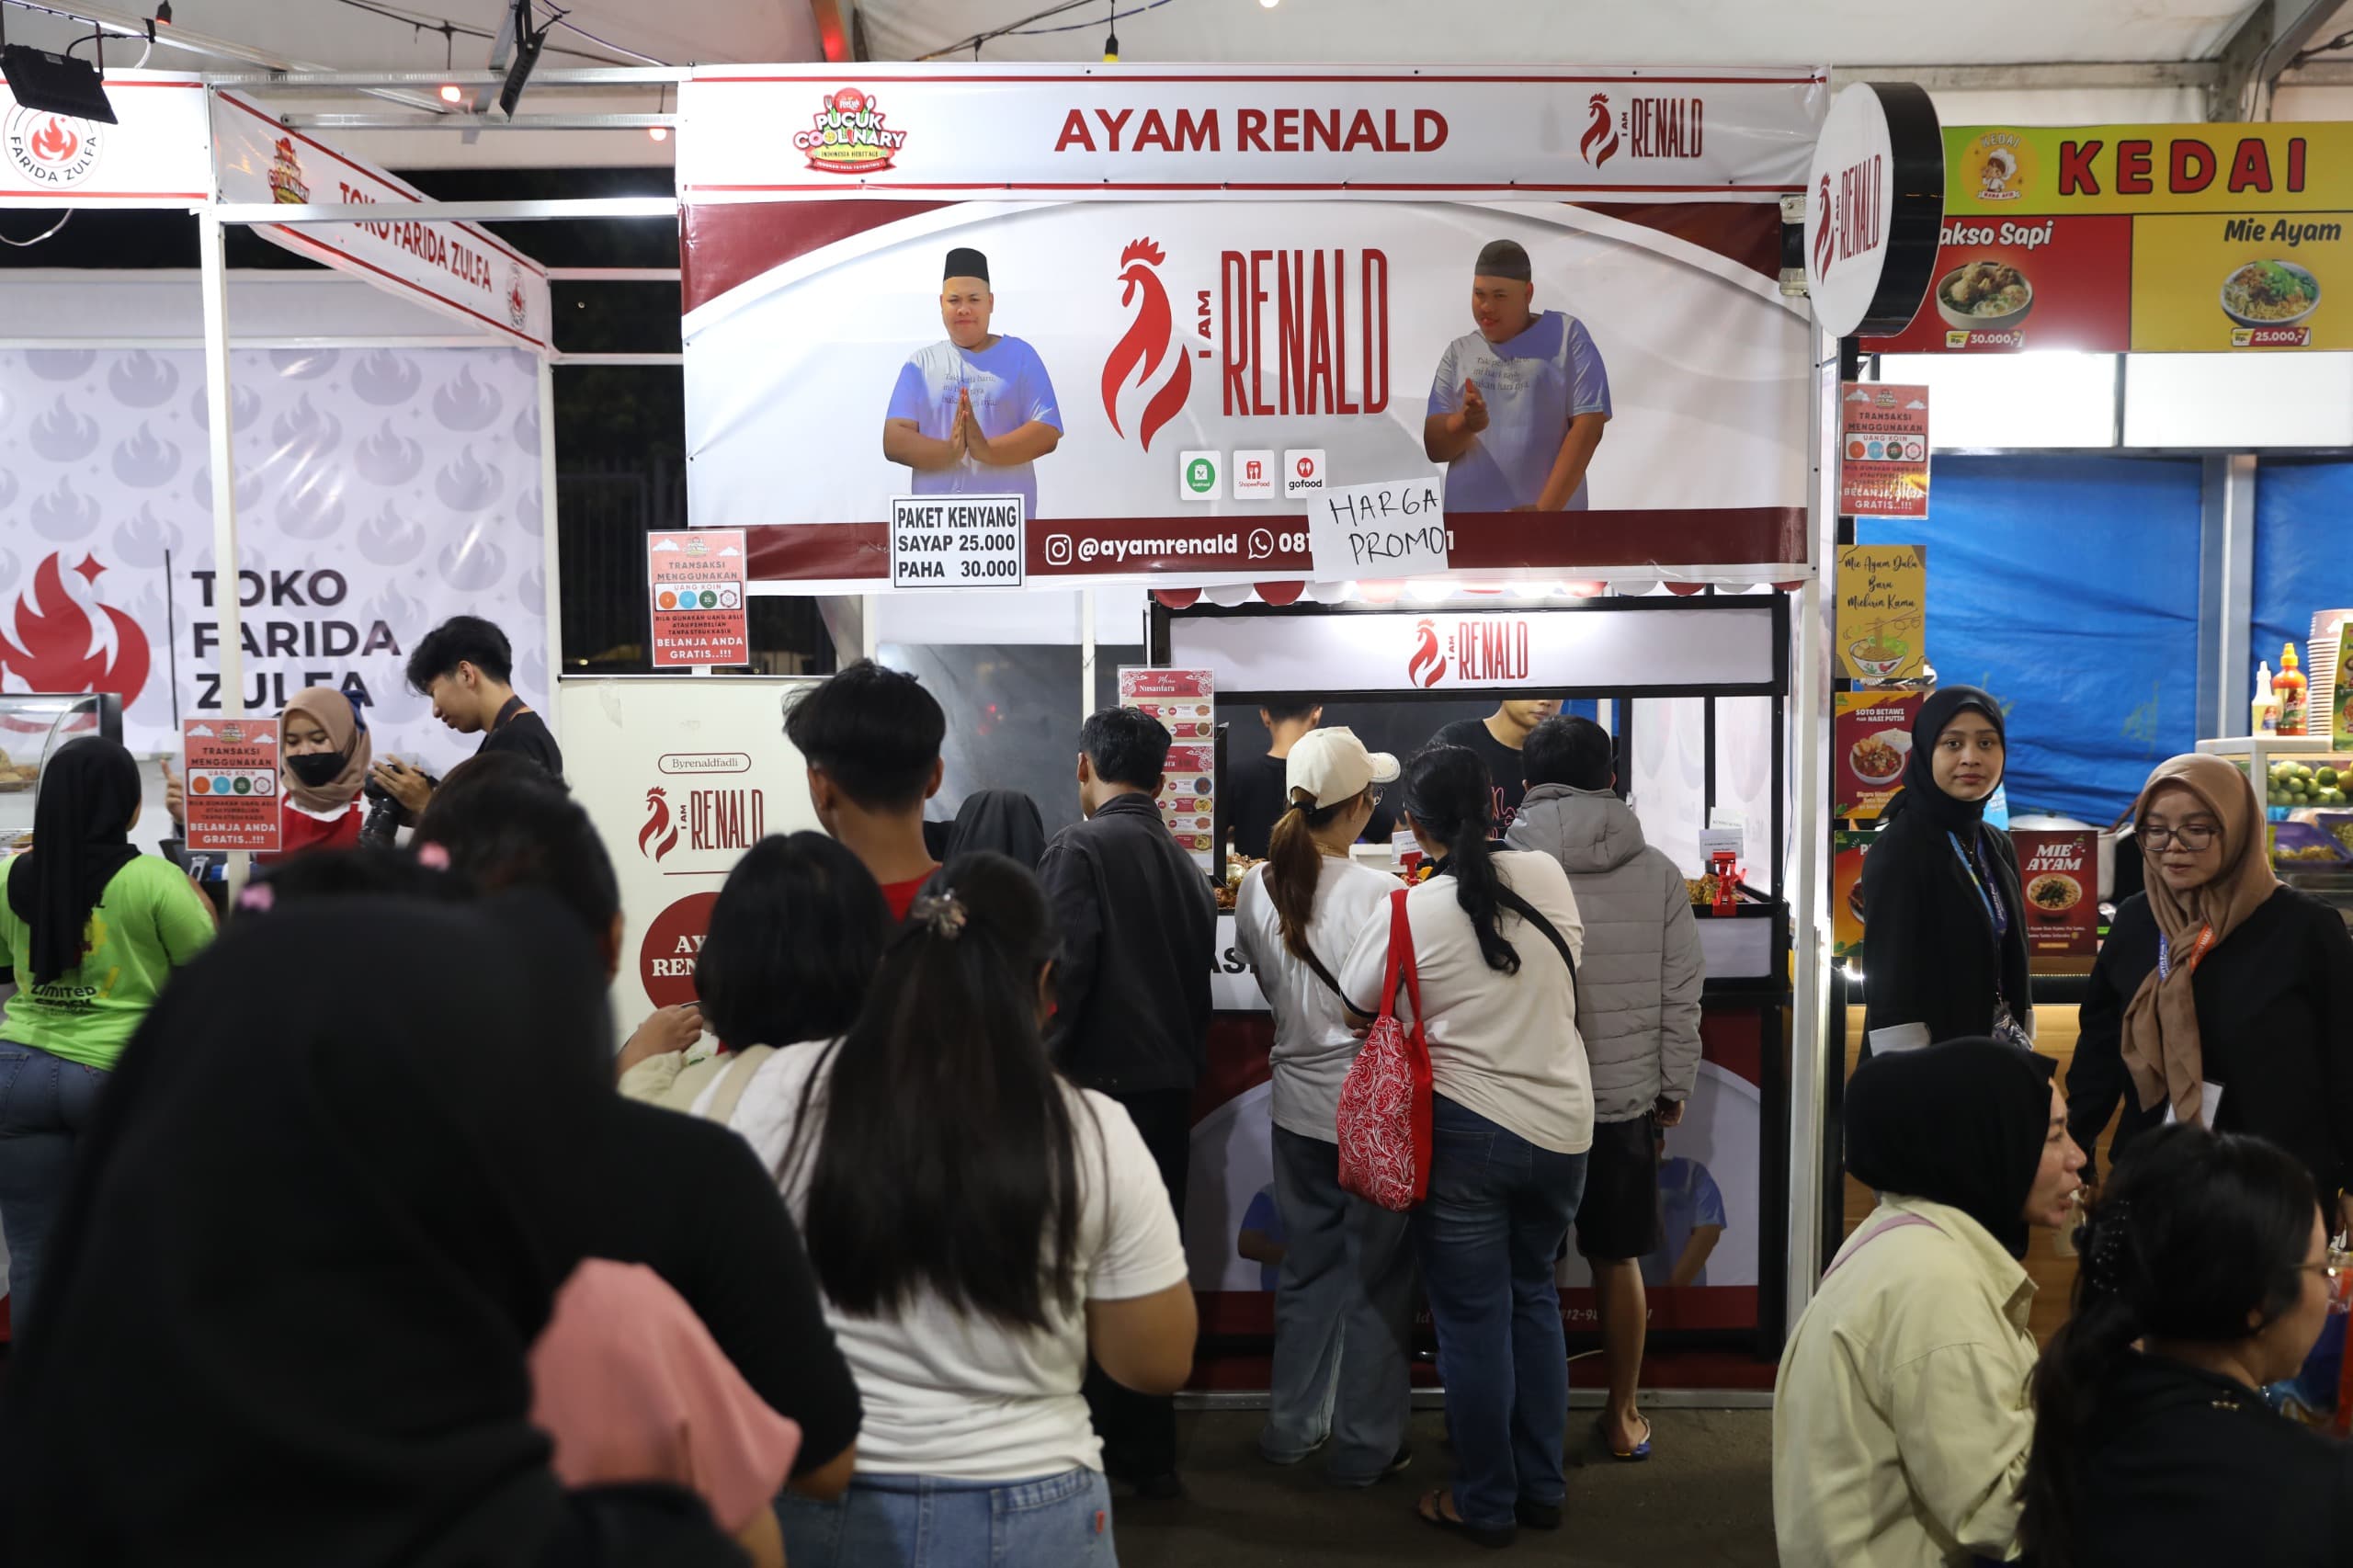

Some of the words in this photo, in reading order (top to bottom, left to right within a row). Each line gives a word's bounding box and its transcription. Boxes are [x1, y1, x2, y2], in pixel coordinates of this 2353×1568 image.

[814, 111, 884, 131] PUCUK
[1054, 108, 1221, 152] AYAM
[1237, 108, 1449, 152] RENALD
[1631, 97, 1703, 158] RENALD
[793, 129, 906, 149] COOLINARY
[1981, 133, 2021, 148] KEDAI
[11, 137, 58, 182] FARIDA
[64, 137, 96, 180] ZULFA
[2058, 138, 2307, 196] KEDAI
[1840, 154, 1881, 261] RENALD
[1940, 222, 1995, 245] akso
[1999, 220, 2053, 250] Sapi
[2224, 218, 2266, 243] Mie
[2270, 219, 2342, 247] Ayam
[393, 221, 449, 270] FARIDA
[450, 241, 492, 293] ZULFA
[1198, 290, 1211, 339] AM
[1222, 248, 1389, 416] RENALD
[1199, 350, 1211, 358] I
[1848, 424, 1923, 432] MENGGUNAKAN
[1289, 479, 1323, 490] gofood
[897, 507, 943, 528] PAKET
[948, 506, 1017, 528] KENYANG
[1329, 488, 1439, 527] HARGA
[898, 535, 953, 551] SAYAP
[959, 534, 1016, 551] 25.000
[1078, 533, 1238, 562] @ayamrenald
[1348, 526, 1445, 565] PROMO
[899, 561, 945, 578] PAHA
[961, 560, 1017, 577] 30.000
[1845, 557, 1860, 571] Mie
[1864, 556, 1890, 573] Ayam
[657, 573, 737, 581] MENGGUNAKAN
[1869, 574, 1893, 592] Baru
[191, 569, 347, 607] TOKO
[1888, 594, 1915, 609] Kamu
[193, 620, 402, 658] FARIDA
[657, 638, 708, 646] BELANJA
[711, 637, 743, 646] ANDA
[1459, 621, 1529, 679] RENALD
[672, 758, 738, 770] Byrenaldfadli
[190, 823, 241, 832] BELANJA
[244, 823, 277, 832] ANDA
[690, 789, 764, 850] RENALD
[2036, 844, 2074, 857] MIE
[2026, 858, 2082, 871] AYAM
[674, 935, 709, 954] AY
